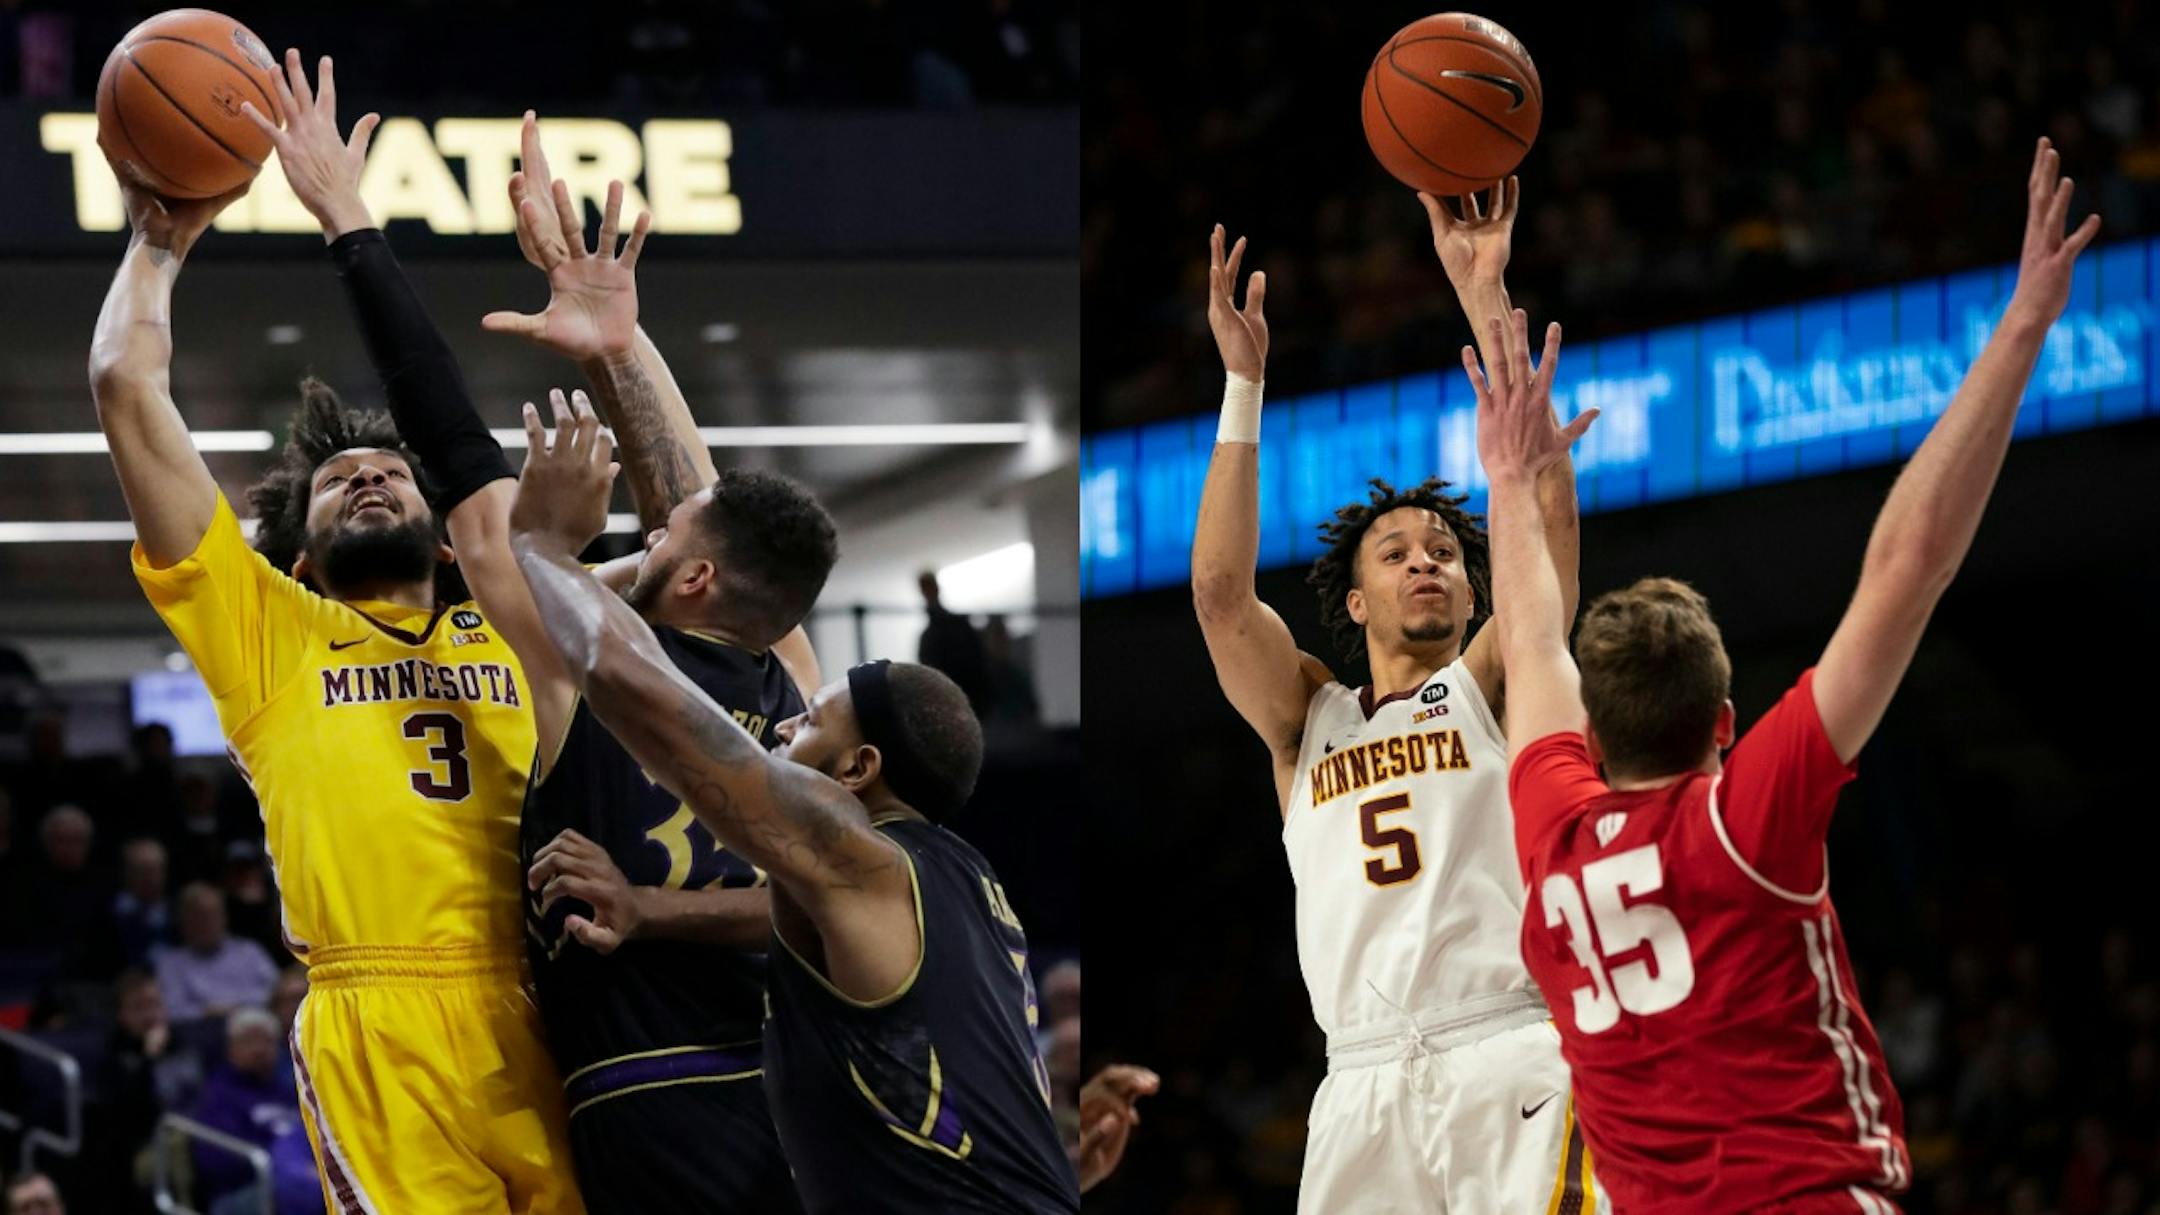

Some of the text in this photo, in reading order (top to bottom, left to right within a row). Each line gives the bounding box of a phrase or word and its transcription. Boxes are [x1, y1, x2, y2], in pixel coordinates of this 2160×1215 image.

[38, 112, 743, 235] TATRE
[321, 658, 521, 709] MINNESOTA
[1423, 685, 1445, 702] TM
[403, 710, 473, 803] 3
[1310, 729, 1472, 810] MINNESOTA
[1358, 790, 1424, 889] 5
[1541, 842, 1696, 1034] 35
